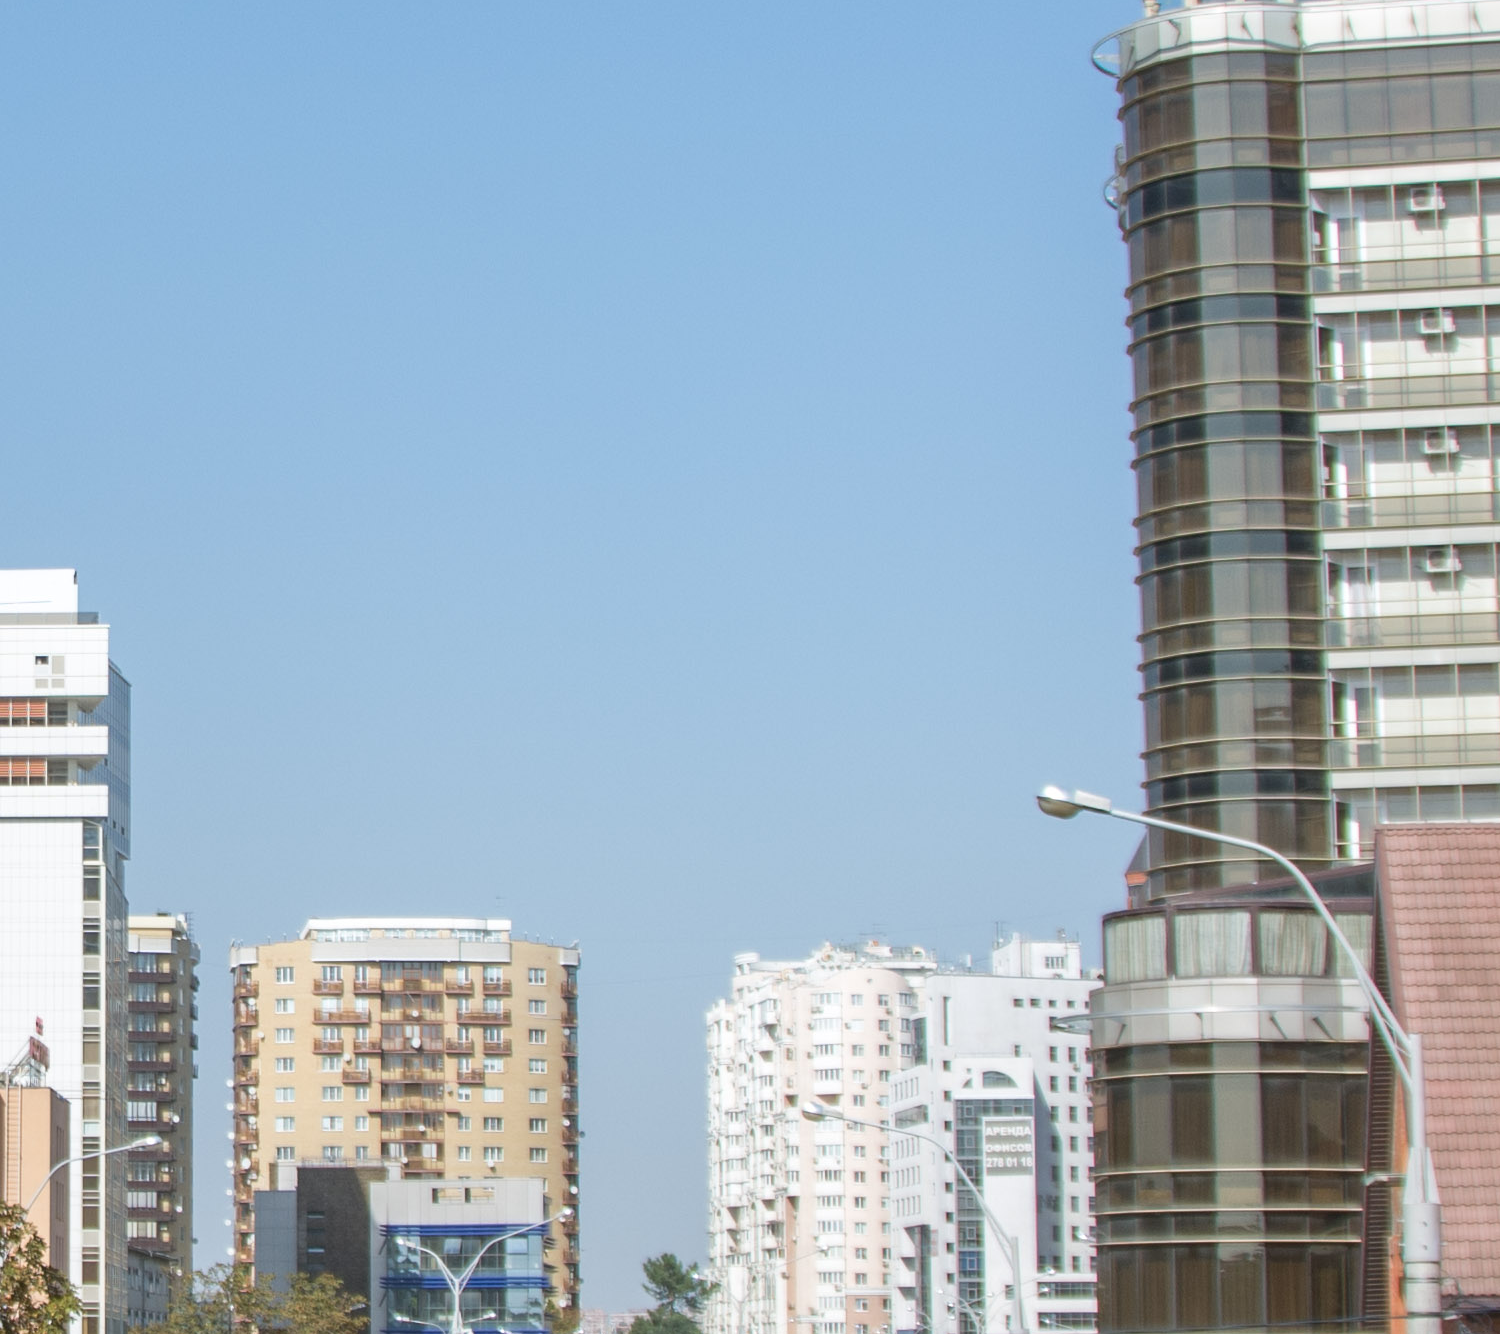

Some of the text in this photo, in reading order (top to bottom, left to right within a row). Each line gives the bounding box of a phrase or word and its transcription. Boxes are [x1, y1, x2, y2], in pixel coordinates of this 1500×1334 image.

[985, 1126, 1032, 1137] АРЕНДА
[985, 1143, 1032, 1153] ОФИСОВ
[986, 1157, 1004, 1168] 278
[1006, 1157, 1018, 1167] 01
